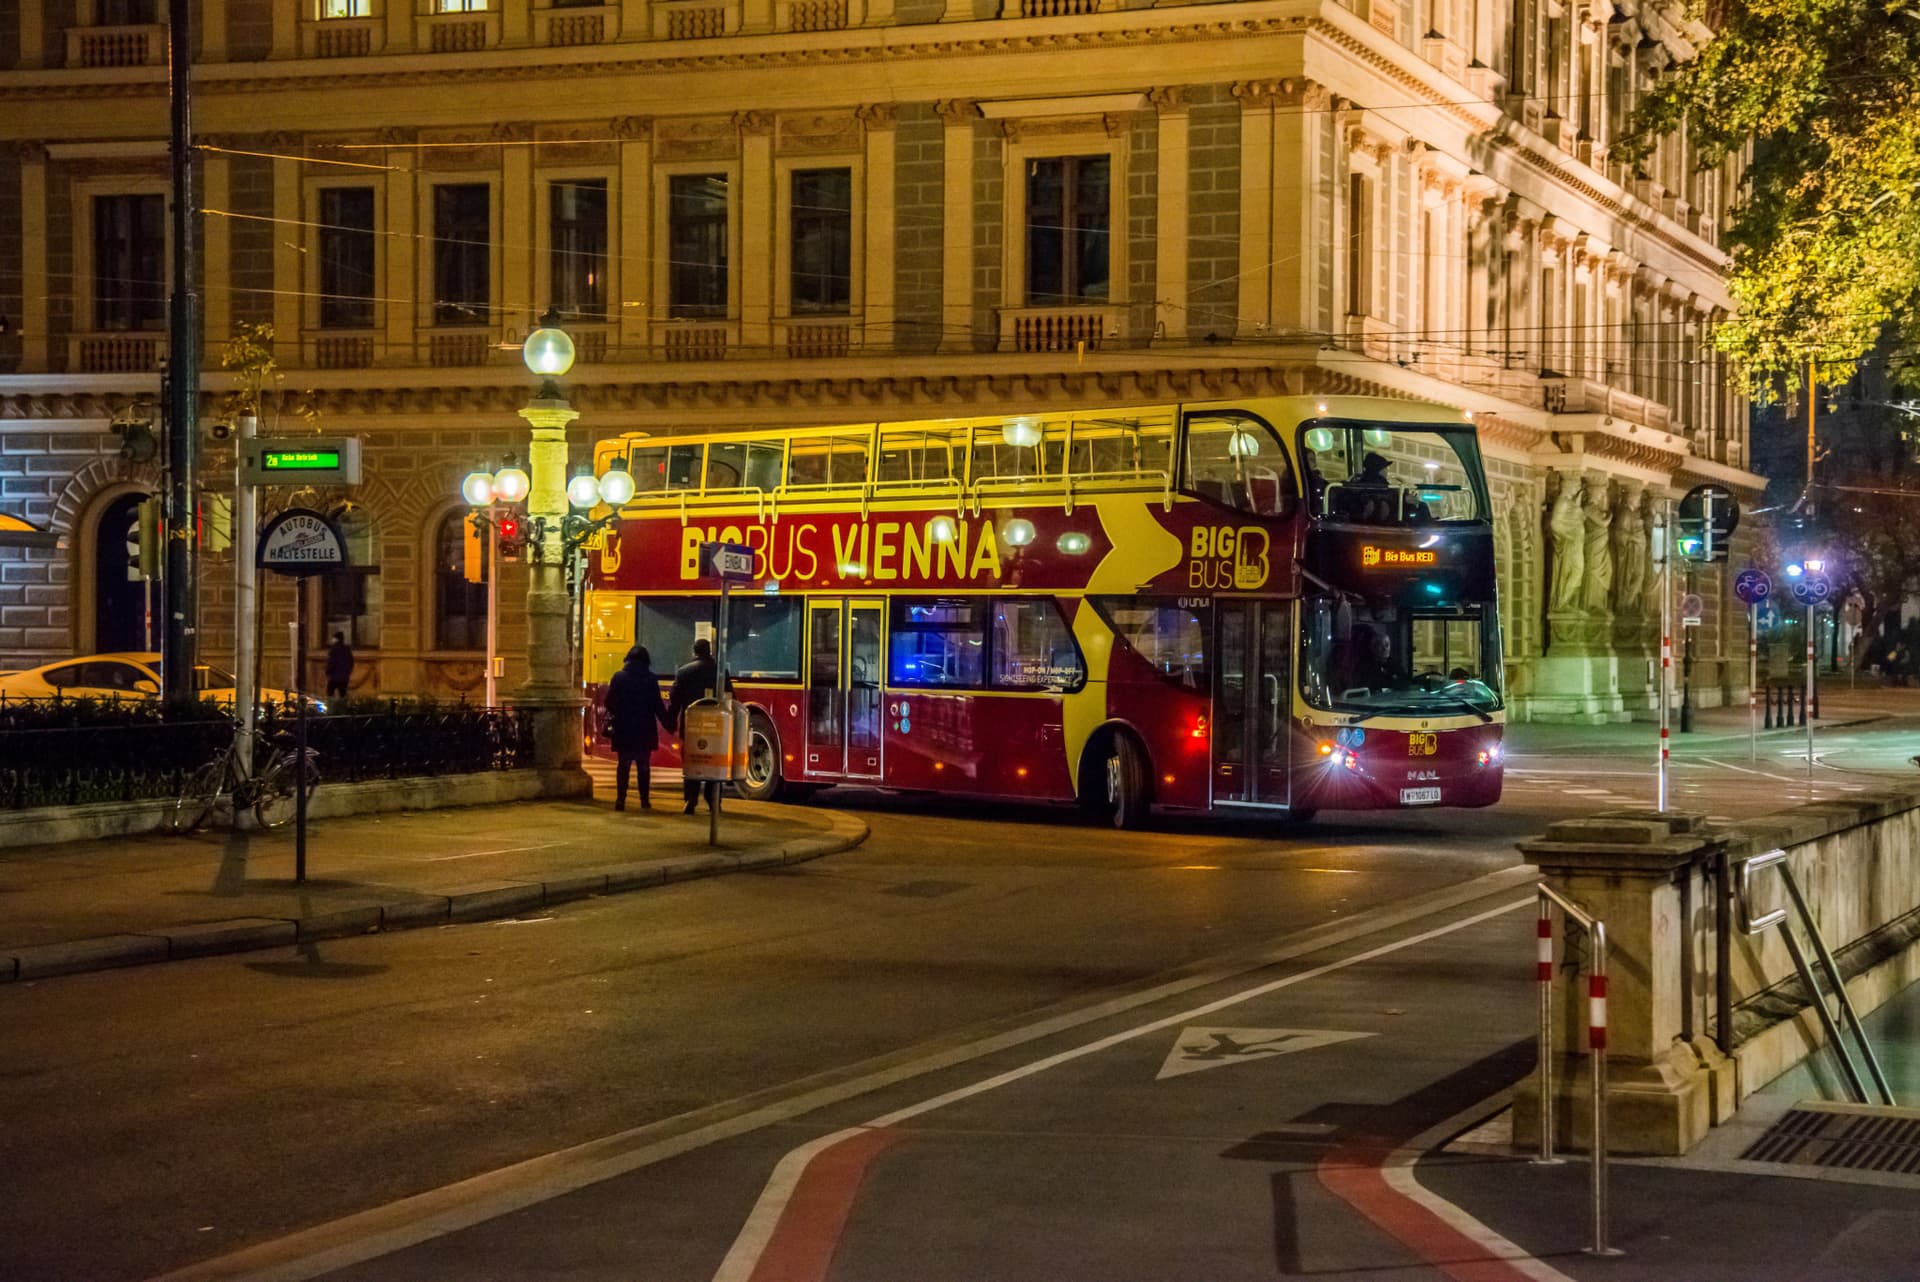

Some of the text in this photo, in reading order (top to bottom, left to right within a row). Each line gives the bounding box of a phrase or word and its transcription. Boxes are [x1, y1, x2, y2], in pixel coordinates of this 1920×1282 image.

[279, 517, 328, 541] AUTOBUS
[270, 547, 335, 560] HALTESTELLE
[832, 520, 1002, 580] VIENNA
[1190, 526, 1235, 558] BIG
[1188, 560, 1234, 589] BUS
[1408, 745, 1424, 756] BUS
[1409, 733, 1425, 745] BIG
